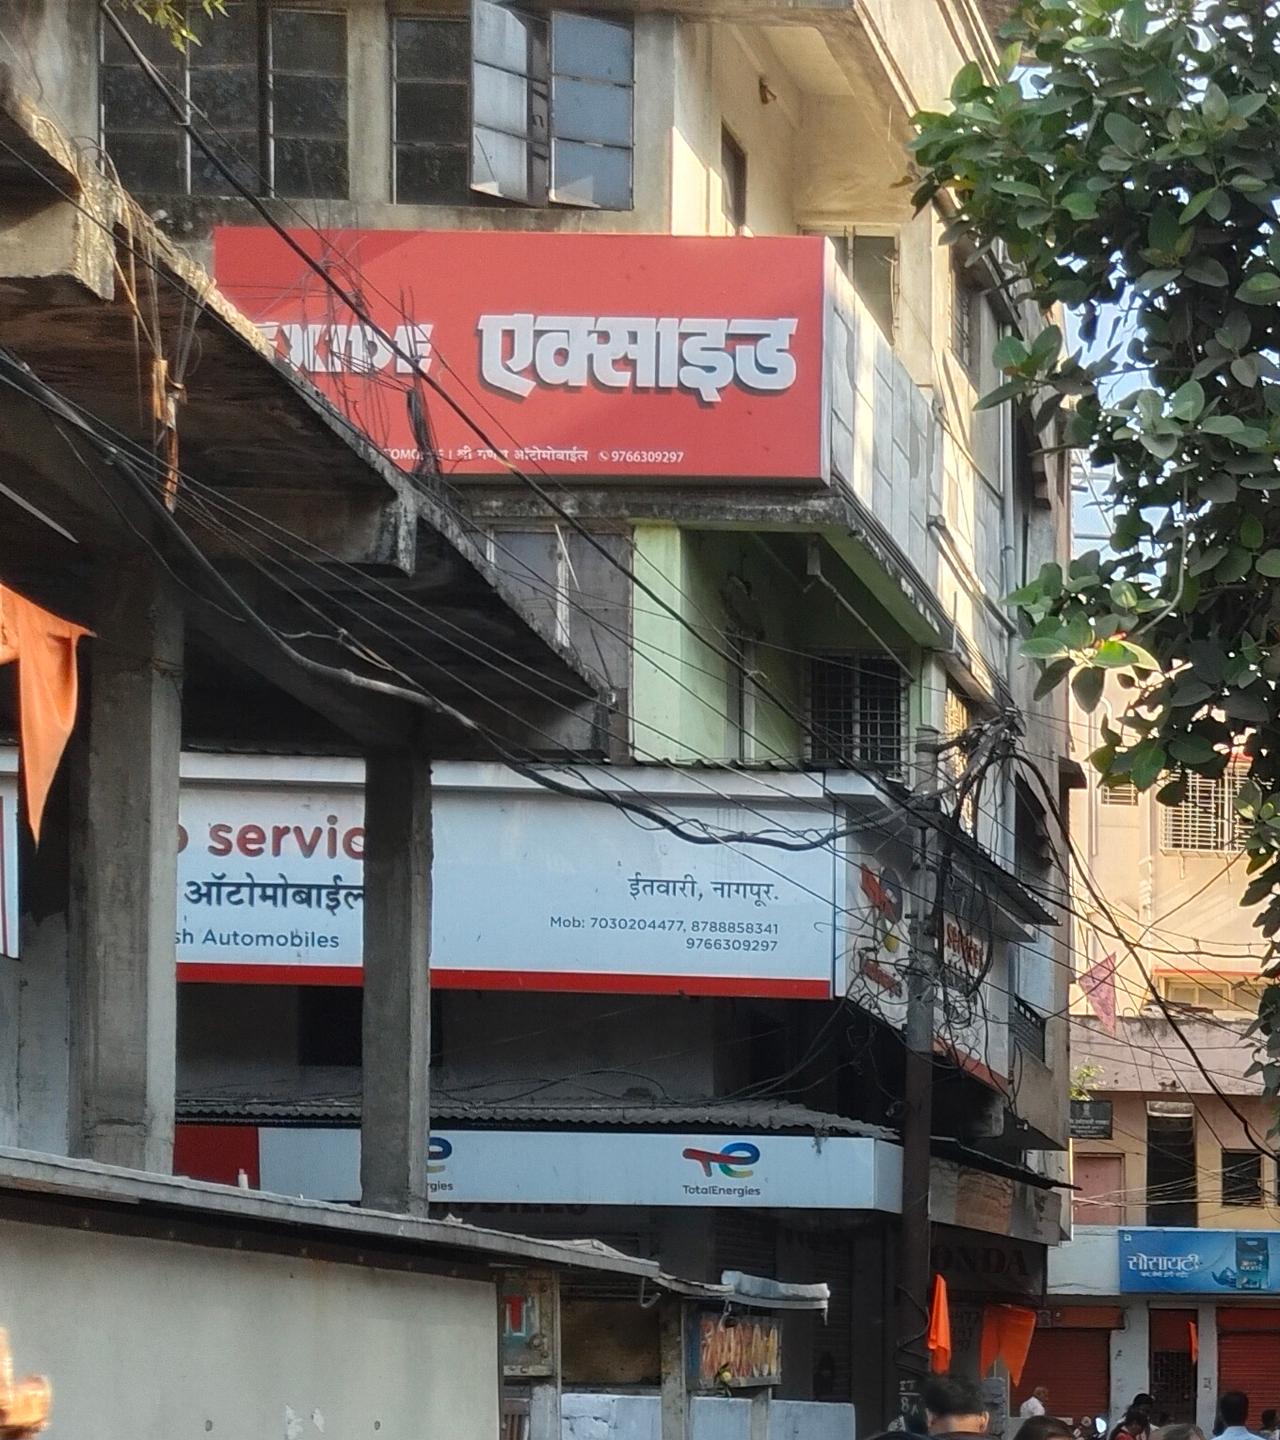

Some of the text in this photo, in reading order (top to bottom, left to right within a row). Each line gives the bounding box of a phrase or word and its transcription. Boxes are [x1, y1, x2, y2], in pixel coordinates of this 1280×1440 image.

[478, 314, 798, 402] एक्साइड
[611, 451, 684, 464] 9766309297
[207, 814, 365, 860] servic
[627, 872, 780, 907] ईतवारी, नागपूर.
[550, 916, 779, 935] Mob: 7030204477, 8788858341
[203, 928, 340, 949] Automobiles
[686, 937, 778, 952] 9766309297
[682, 1185, 761, 1198] TotalEnergies
